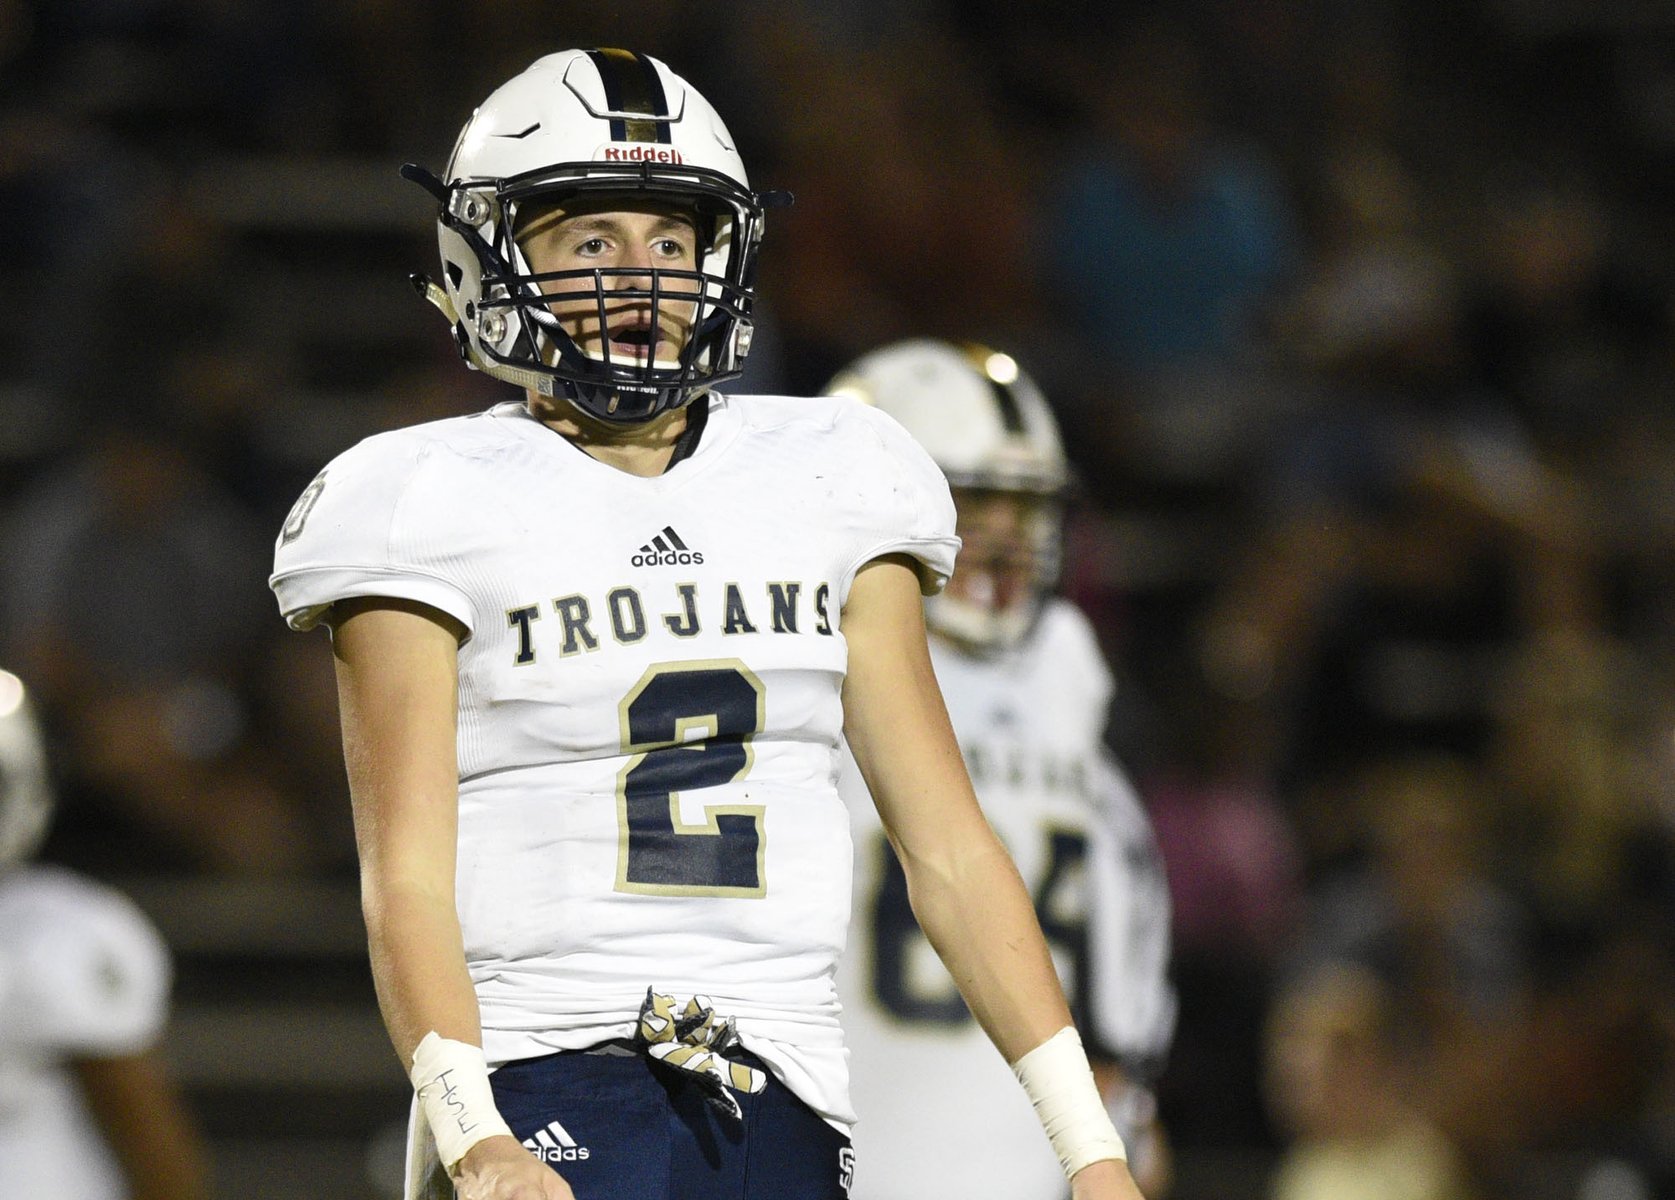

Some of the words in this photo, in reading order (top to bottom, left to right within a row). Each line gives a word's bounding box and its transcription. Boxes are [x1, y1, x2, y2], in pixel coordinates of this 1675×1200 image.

[605, 146, 682, 166] Riddell
[631, 551, 704, 567] adidas
[506, 581, 834, 667] TROJANS
[613, 657, 767, 899] 2
[531, 1145, 590, 1162] didas
